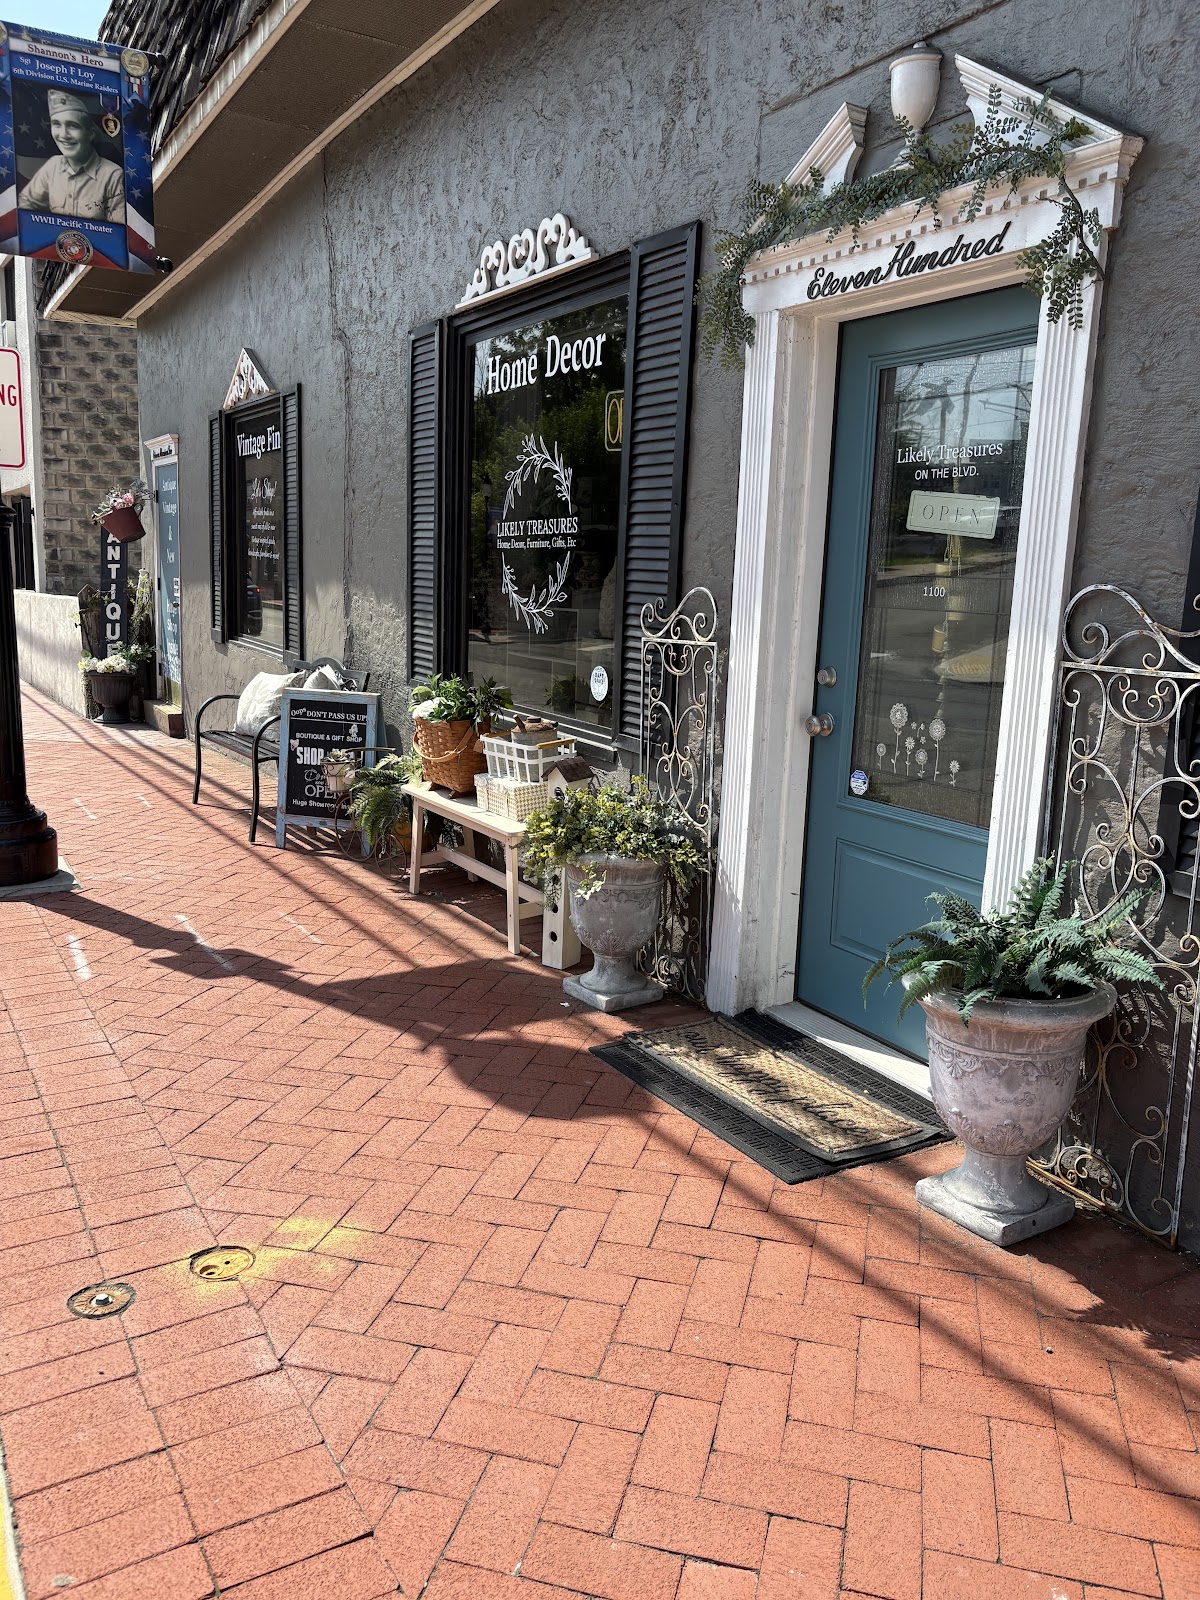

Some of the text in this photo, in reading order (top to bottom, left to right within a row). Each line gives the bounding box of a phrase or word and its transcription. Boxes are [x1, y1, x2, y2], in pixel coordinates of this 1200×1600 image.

[28, 44, 77, 62] Shannon's
[81, 55, 104, 67] Hero
[19, 56, 95, 82] Sgt Joseph F Loy
[13, 67, 119, 94] 6th Division U.S. Marine Raiders
[31, 214, 113, 234] WWII Pacific Theater
[807, 221, 1012, 300] Eleven Hundred
[487, 332, 606, 395] Home Decor
[237, 432, 266, 460] Vintage
[896, 442, 1003, 465] Likely Treasures
[915, 466, 980, 480] ON THE BLVD.
[922, 504, 983, 526] OPEN
[497, 516, 578, 537] LIKELY TREASURES
[526, 538, 551, 549] Furniture,
[923, 586, 946, 598] 1100
[290, 707, 306, 717] Oops
[307, 711, 327, 719] DON'T
[328, 712, 345, 720] PASS
[296, 747, 324, 766] SHOP
[292, 799, 307, 807] Huge
